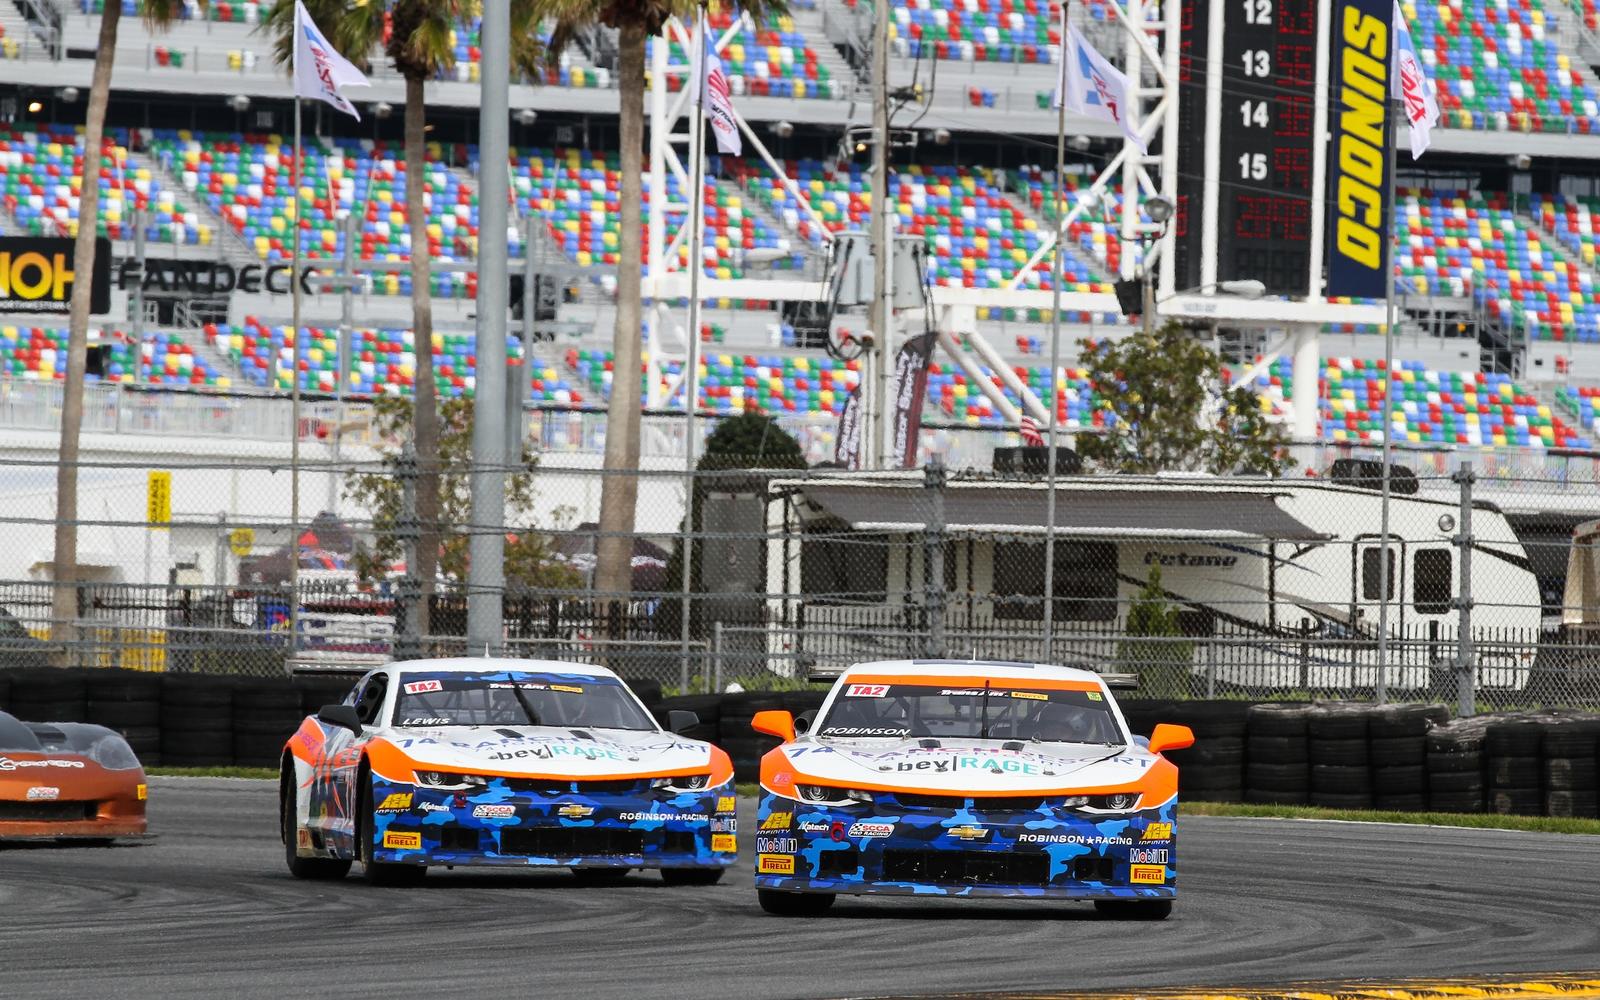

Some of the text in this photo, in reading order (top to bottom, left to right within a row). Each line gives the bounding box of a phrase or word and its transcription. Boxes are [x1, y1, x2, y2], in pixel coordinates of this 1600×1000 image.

[1243, 0, 1272, 25] 12
[1241, 49, 1271, 78] 13
[1239, 100, 1269, 128] 14
[1337, 5, 1387, 270] SUNOCO
[1238, 152, 1268, 181] 15
[408, 683, 437, 692] TA2
[851, 686, 883, 696] TA2
[402, 717, 450, 725] LEWIS
[822, 726, 910, 736] ROBINSON
[788, 747, 834, 758] 74
[619, 812, 709, 821] ROBINSON RACING
[761, 812, 793, 829] AEM
[1143, 823, 1172, 839] AEM
[387, 835, 417, 846] PIRELLI
[757, 838, 787, 853] Mobil
[1018, 834, 1133, 845] ROBINSON RACING
[1129, 848, 1158, 863] Mobil
[763, 858, 791, 870] PIRELLI
[1134, 868, 1162, 880] PIRELLI
